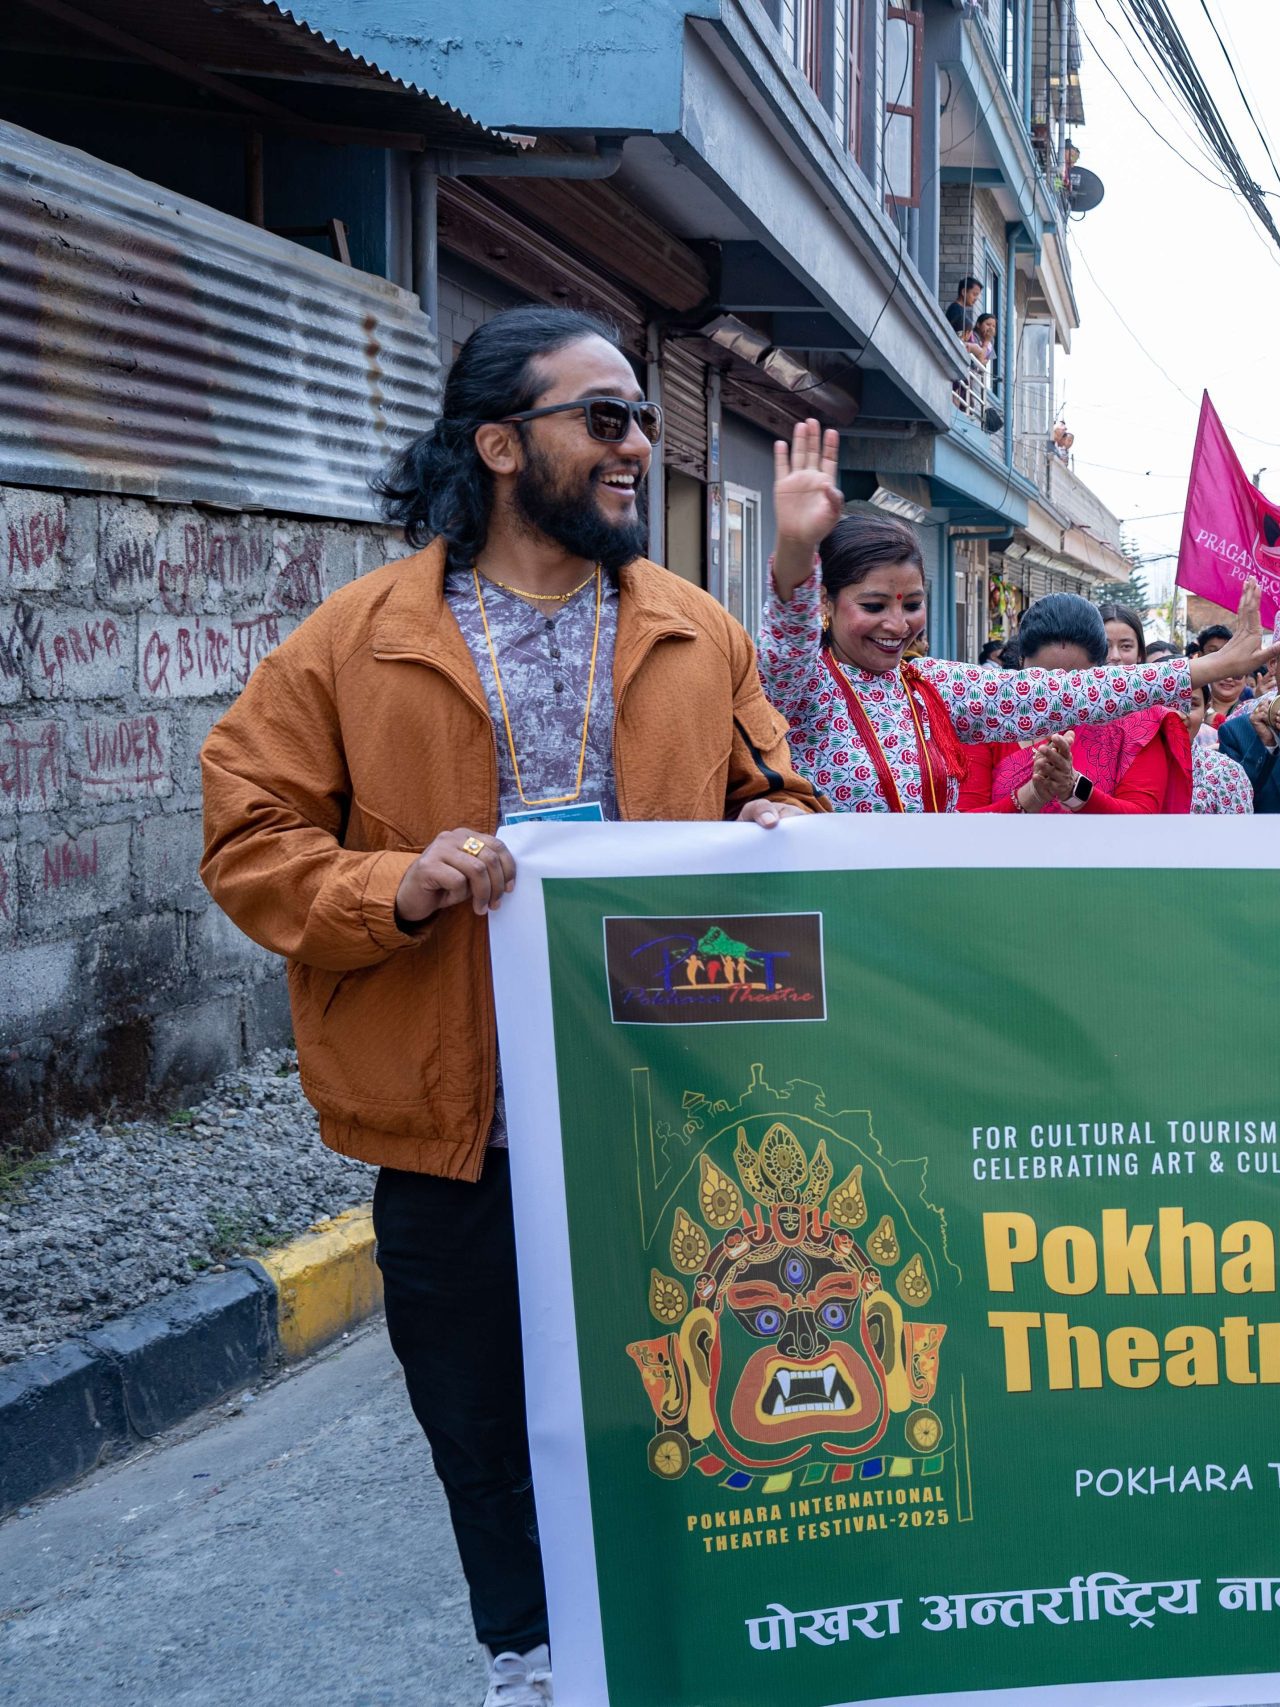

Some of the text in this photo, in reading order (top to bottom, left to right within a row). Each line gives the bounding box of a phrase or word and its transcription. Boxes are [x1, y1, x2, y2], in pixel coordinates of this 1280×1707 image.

[8, 507, 66, 574] NEW
[1194, 529, 1257, 573] PRAGAT
[85, 715, 164, 774] UNDER
[44, 834, 98, 894] NEW
[727, 983, 815, 1003] Theatre
[972, 1120, 1277, 1150] FOR CULTURAL TOURISM
[973, 1152, 1138, 1181] CELEBRATING
[1151, 1151, 1196, 1175] ART
[1209, 1150, 1224, 1173] &
[1076, 1464, 1253, 1497] POKHARA
[687, 1486, 944, 1532] POKHARA INTERNATIONAL
[703, 1509, 949, 1553] THEATRE FESTIVAL-2025
[744, 1598, 903, 1650] पोखरा
